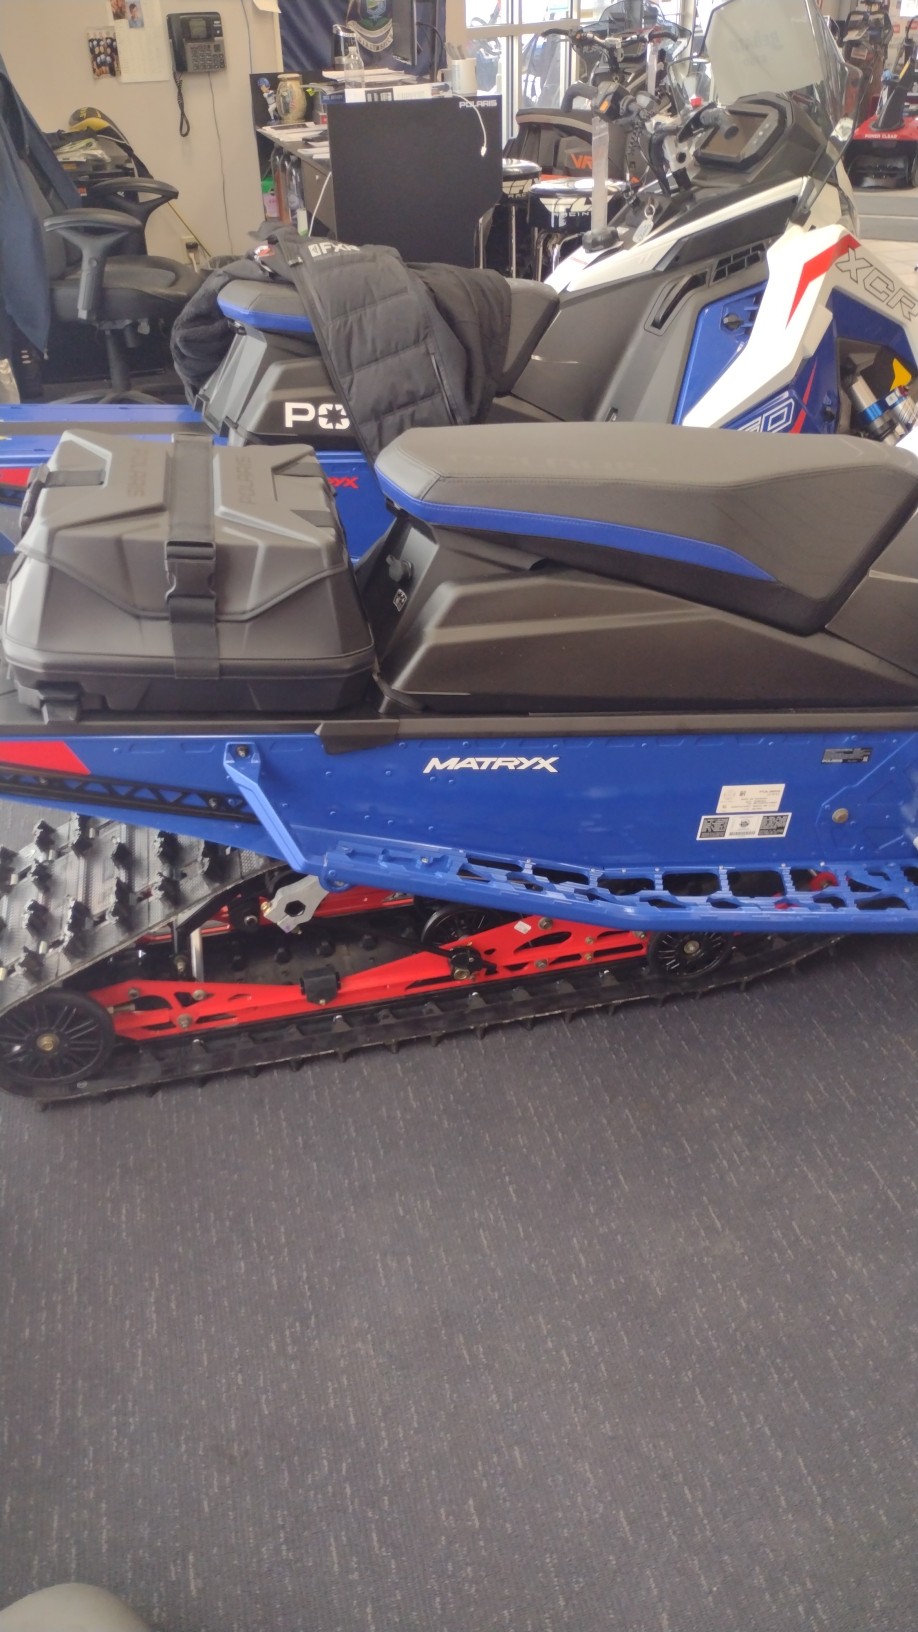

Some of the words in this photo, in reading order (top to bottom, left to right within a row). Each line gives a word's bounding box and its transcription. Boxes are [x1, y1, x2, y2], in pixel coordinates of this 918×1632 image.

[458, 99, 498, 109] POLARIS
[835, 244, 918, 322] XCR
[235, 455, 257, 506] POLARIS
[422, 756, 560, 774] MATRYX
